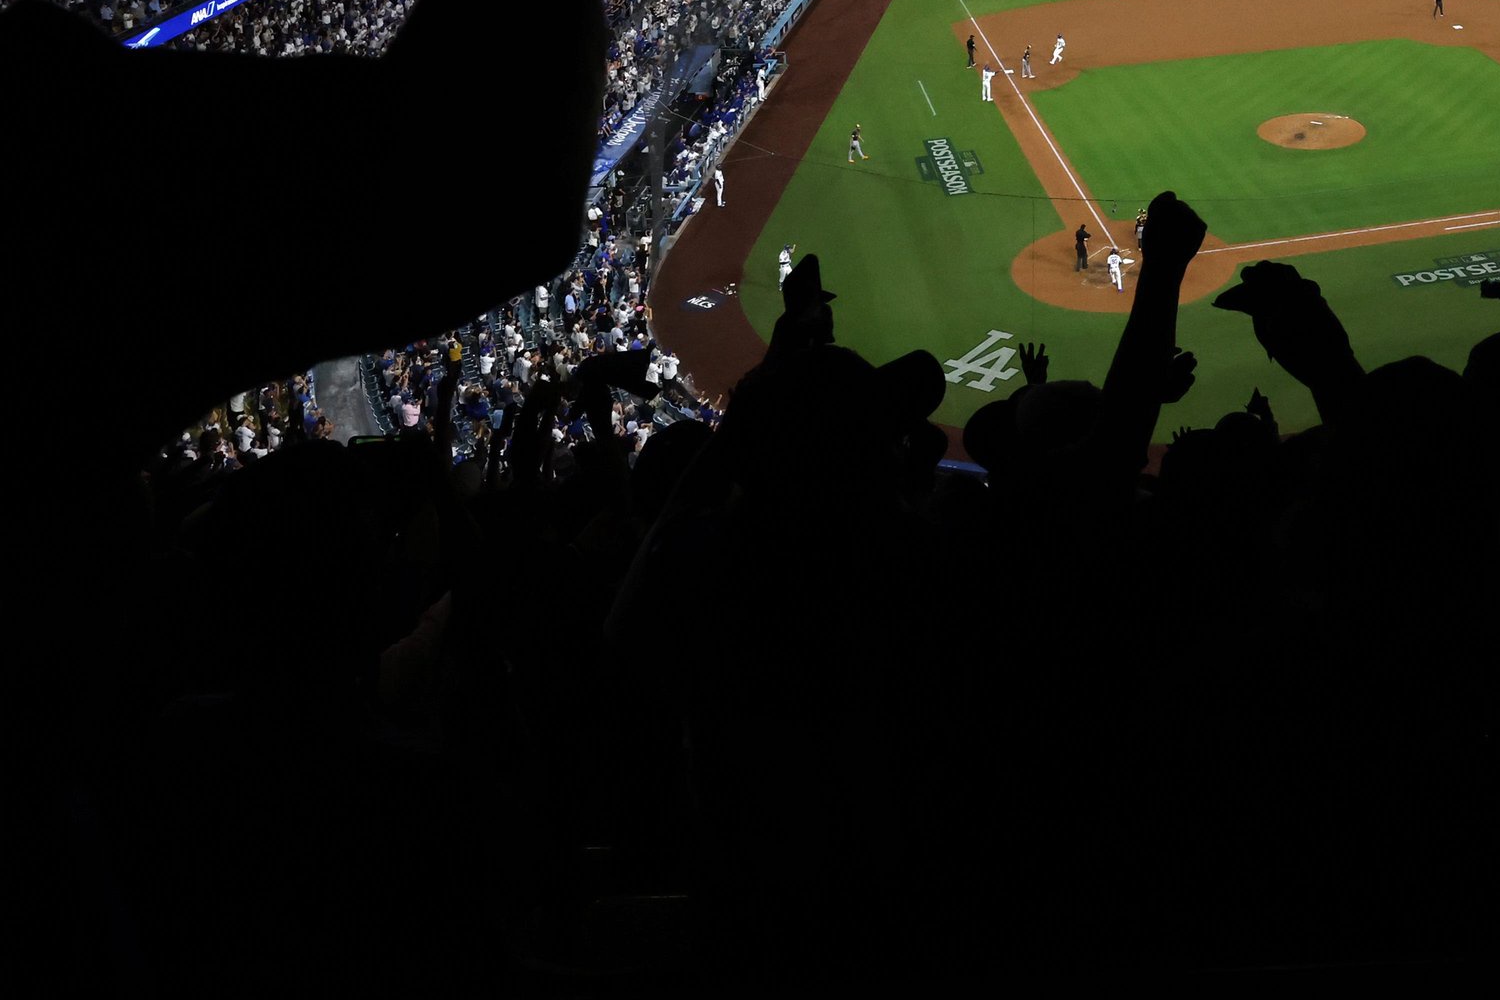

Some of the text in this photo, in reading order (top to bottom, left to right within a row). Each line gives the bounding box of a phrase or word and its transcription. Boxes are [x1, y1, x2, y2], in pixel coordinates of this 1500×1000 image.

[191, 8, 208, 25] ANA
[927, 138, 969, 195] POSTSEASON
[687, 298, 715, 308] NLCS
[944, 329, 1020, 392] LA
